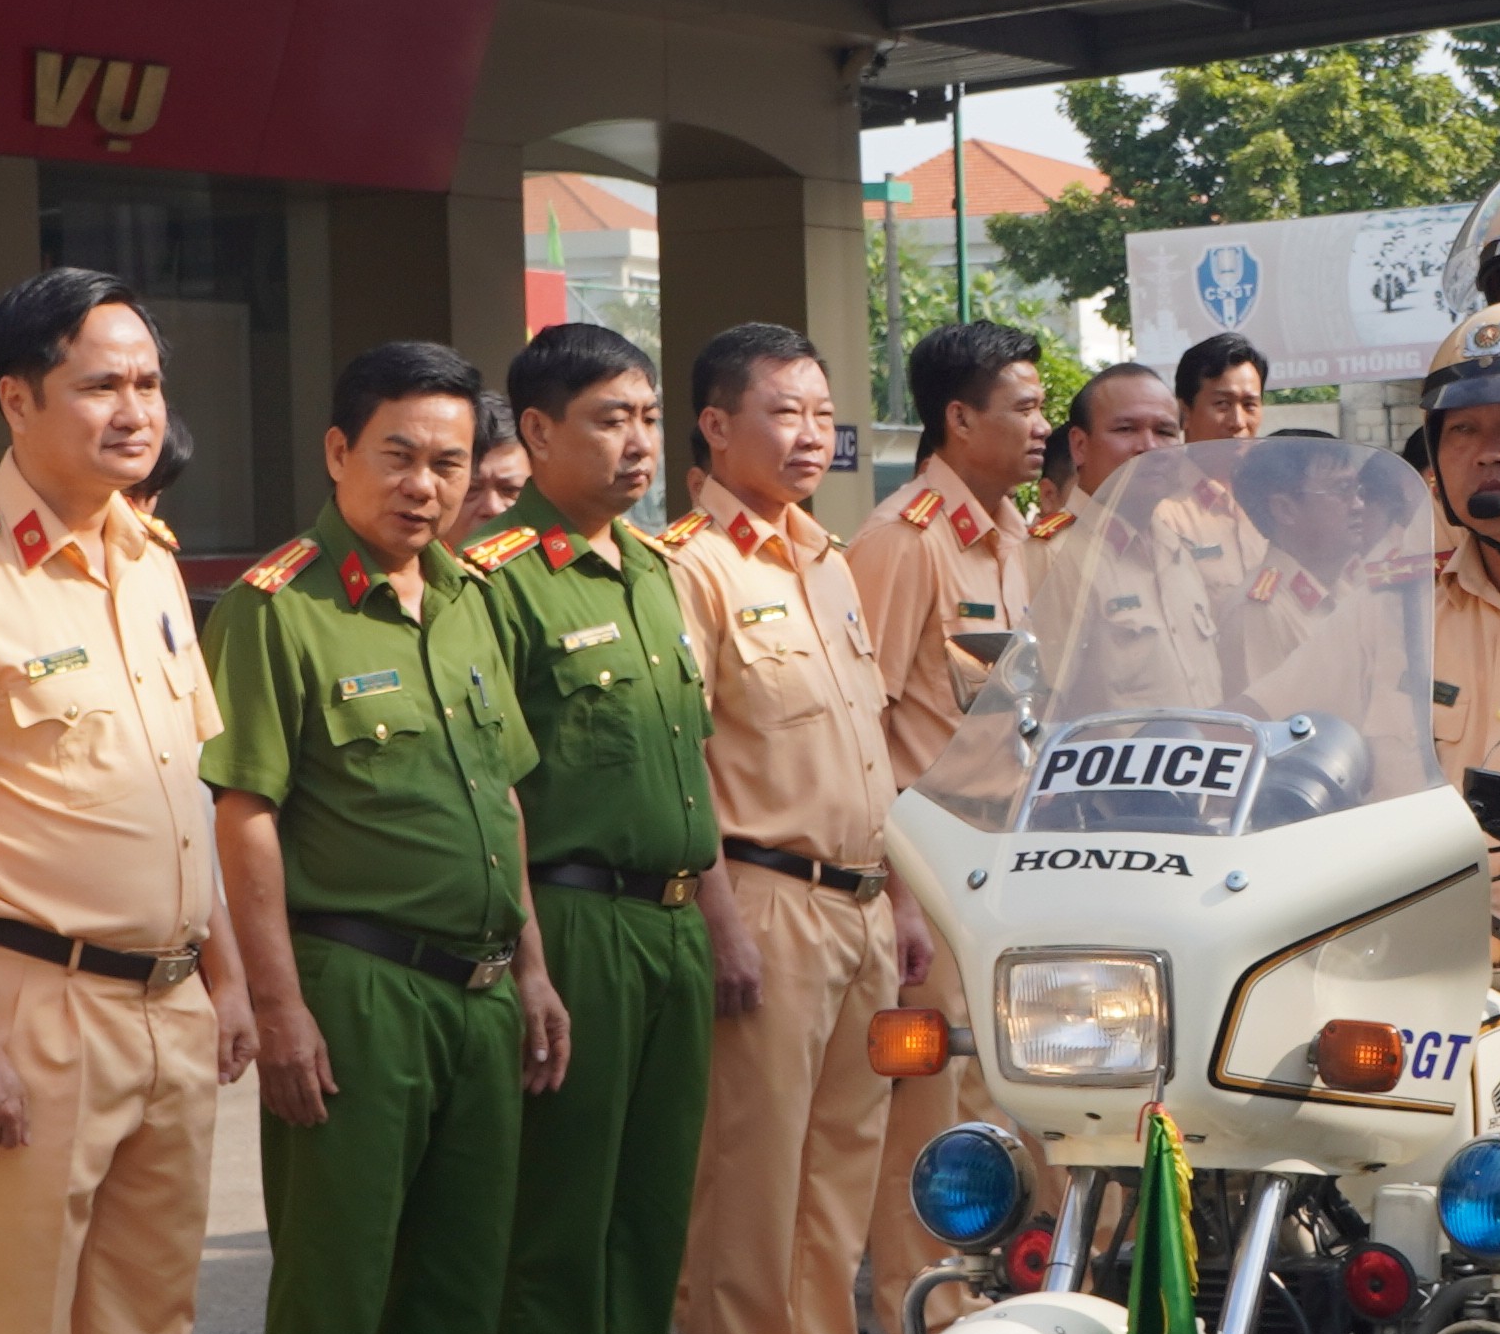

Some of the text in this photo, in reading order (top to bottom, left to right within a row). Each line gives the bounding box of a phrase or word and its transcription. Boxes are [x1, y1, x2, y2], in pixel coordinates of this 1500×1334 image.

[34, 49, 172, 153] VỤ
[1270, 359, 1329, 381] GIAO
[1336, 347, 1422, 374] THÔNG
[1037, 744, 1245, 792] POLICE
[1010, 850, 1194, 877] HONDA
